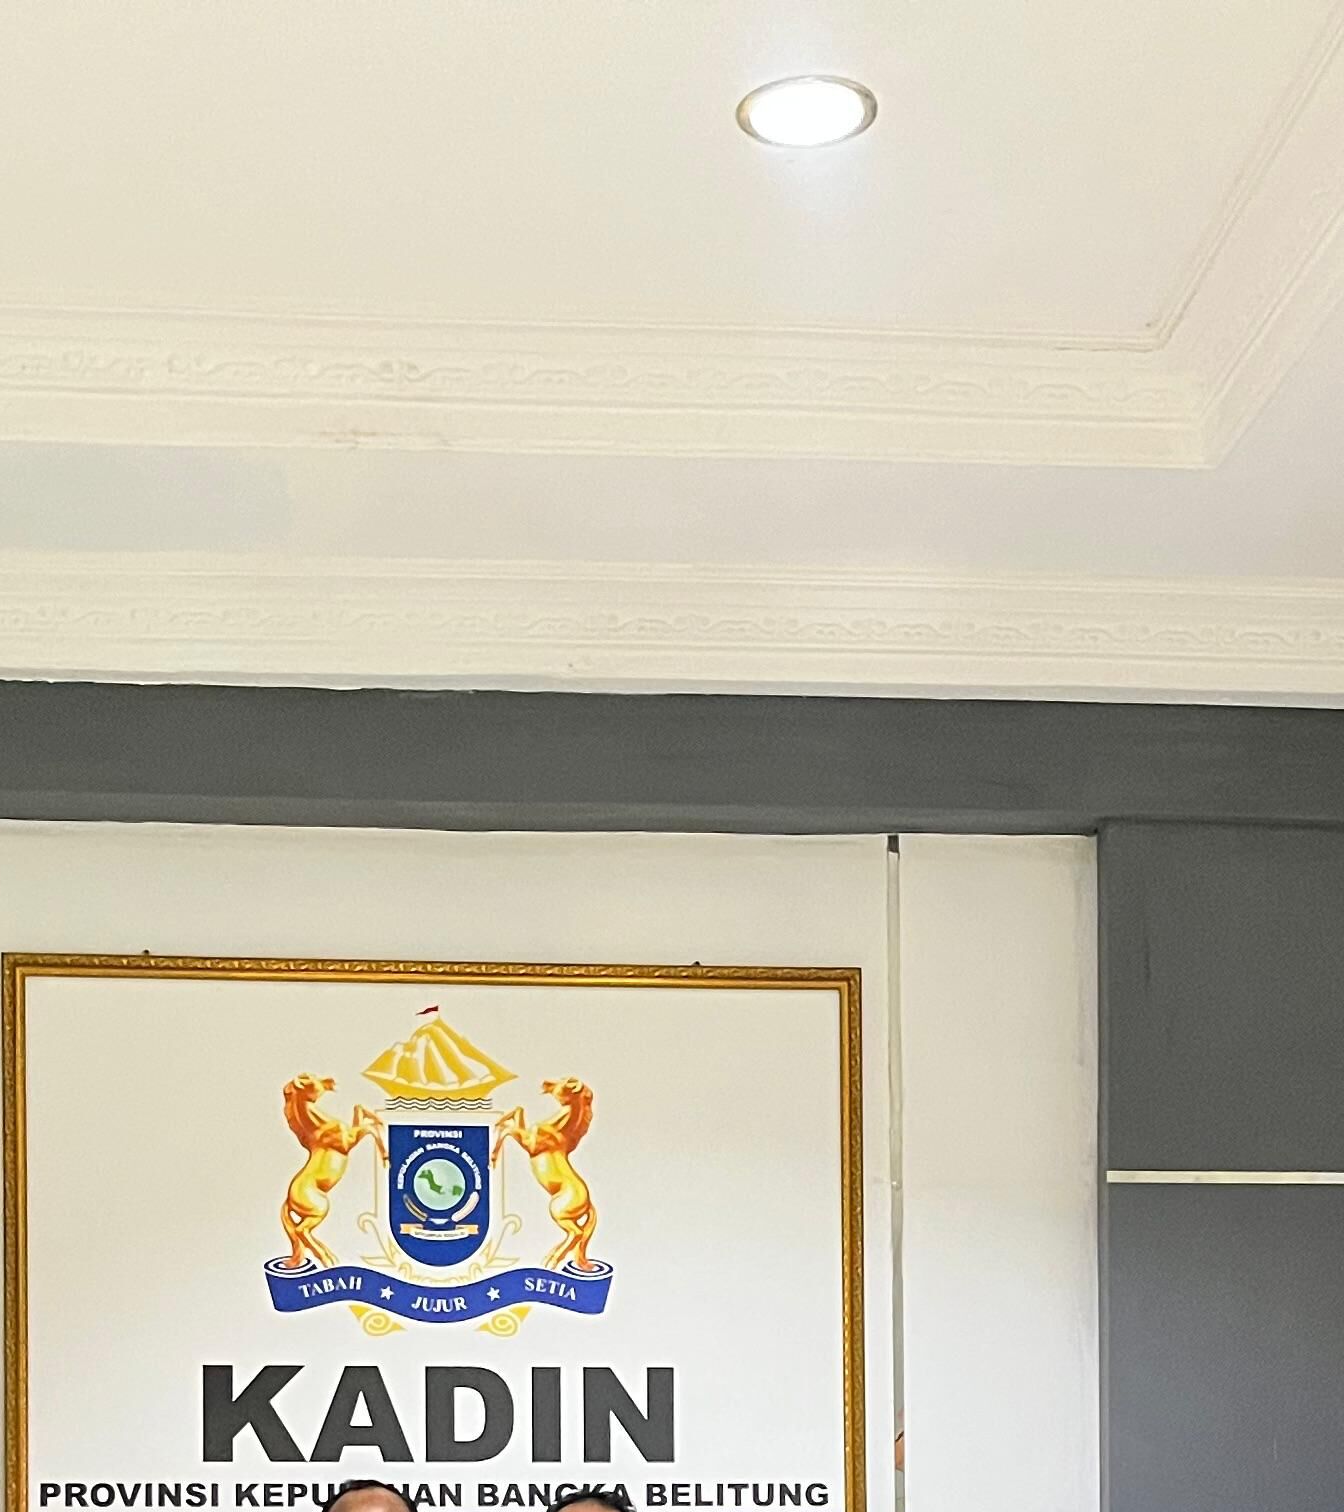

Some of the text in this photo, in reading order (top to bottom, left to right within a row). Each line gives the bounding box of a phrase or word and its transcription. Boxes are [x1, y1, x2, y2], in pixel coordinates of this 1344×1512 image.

[298, 1276, 578, 1313] TABAH JUJUR SETIA
[202, 1364, 675, 1463] KADIN
[39, 1482, 219, 1508] PROVINSI
[235, 1482, 462, 1508] KEPUAN
[646, 1482, 829, 1507] BELITUNG
